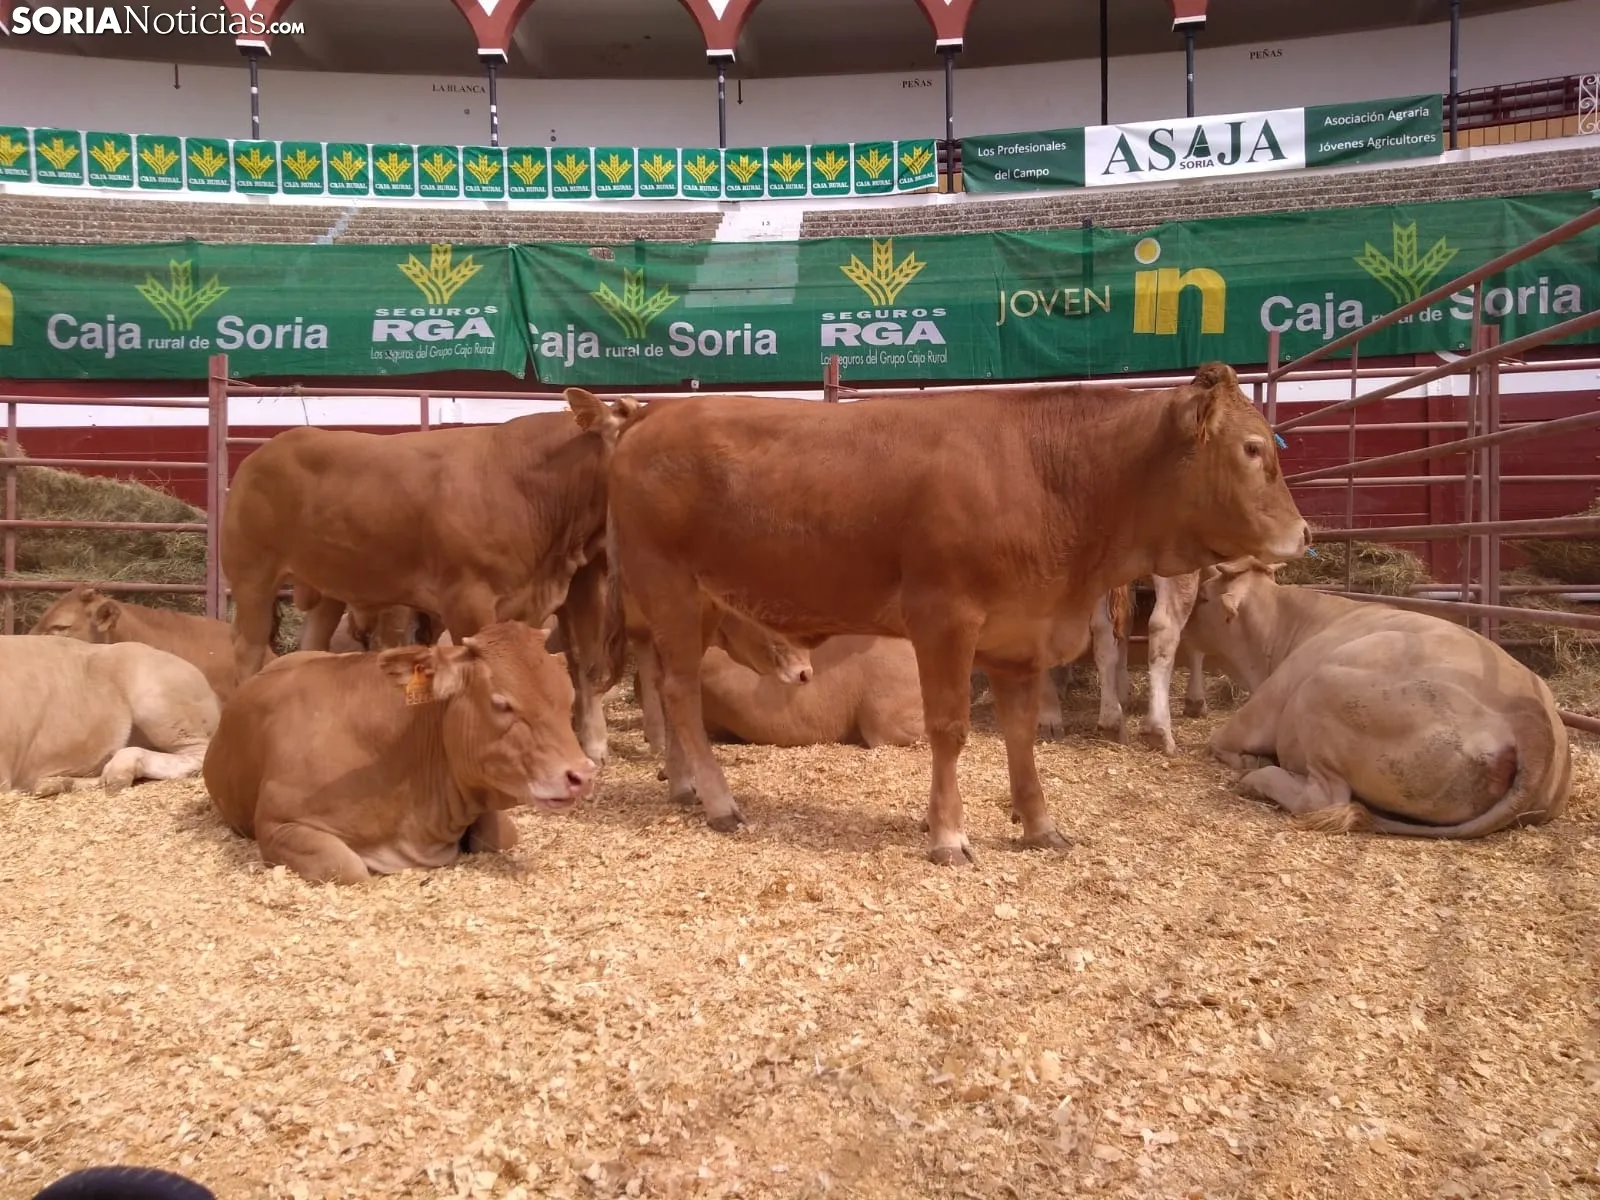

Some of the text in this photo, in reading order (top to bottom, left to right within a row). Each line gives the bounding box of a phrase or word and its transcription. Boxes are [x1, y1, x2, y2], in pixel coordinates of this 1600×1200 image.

[1324, 106, 1430, 126] Asociación Agraria
[977, 140, 1067, 157] Los Profesionales
[1101, 119, 1289, 175] ASAJA
[1318, 133, 1436, 153] Jóvenes Agricultores
[994, 168, 1050, 180] del Campo
[1179, 159, 1214, 170] SORIA
[375, 305, 499, 317] SEGUROS
[822, 308, 947, 321] SEGUROS
[996, 285, 1110, 326] JOVEN
[1260, 292, 1364, 340] Caja
[1419, 307, 1443, 322] de
[47, 313, 328, 359] Caja rural de Soria
[372, 316, 496, 342] RGA
[821, 320, 947, 347] RGA
[416, 345, 428, 359] del
[429, 345, 453, 359] Grupo
[454, 343, 472, 358] Caja
[474, 341, 496, 355] Rural
[528, 321, 778, 368] aja rural de Soria
[821, 347, 948, 368] Lo eguros del Grupo Caja Rural
